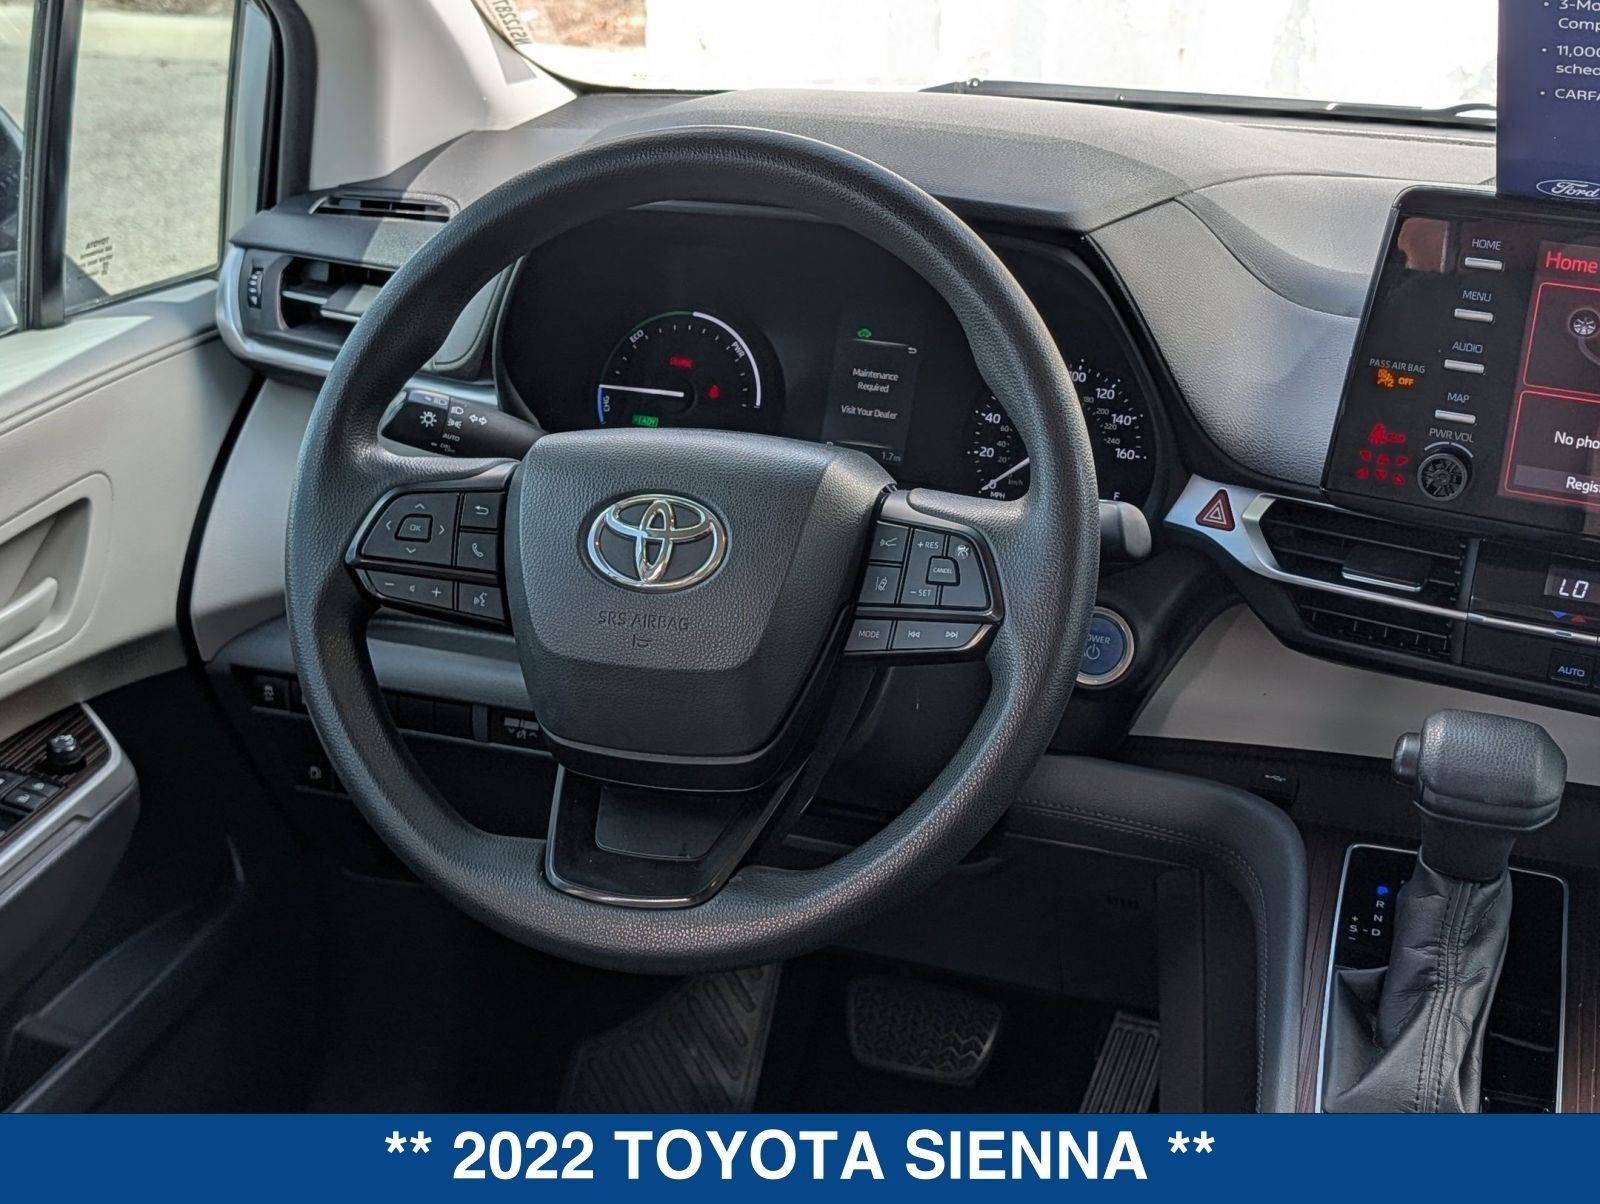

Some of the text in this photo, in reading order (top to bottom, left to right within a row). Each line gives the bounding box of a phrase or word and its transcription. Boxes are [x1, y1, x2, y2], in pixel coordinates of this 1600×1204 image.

[1551, 181, 1600, 199] Ford
[1471, 238, 1502, 251] HOME
[1545, 251, 1599, 274] Home
[1462, 290, 1492, 303] MENU
[629, 329, 645, 343] ECO
[731, 341, 745, 359] PWR
[1452, 341, 1483, 354] AUDIO
[1369, 358, 1391, 369] PASS
[1391, 361, 1407, 371] AIR
[852, 367, 899, 382] Maintenance
[1069, 371, 1087, 383] 00
[857, 381, 890, 393] Required
[1398, 377, 1415, 386] OFF
[1095, 387, 1116, 400] 120
[1447, 392, 1470, 403] MAP
[840, 404, 898, 420] Visit Your Dealer
[984, 412, 1001, 425] 40
[1111, 413, 1133, 426] 140
[442, 432, 461, 442] AUTO
[1428, 426, 1475, 444] PWR VOL
[1554, 430, 1573, 446] No
[979, 446, 995, 458] 20
[1115, 447, 1135, 461] 160
[1566, 476, 1600, 494] Regis
[1113, 492, 1121, 500] F
[409, 523, 421, 532] OK
[1558, 578, 1590, 599] LO
[598, 610, 626, 626] SRS
[858, 629, 880, 639] MODE
[1087, 632, 1111, 645] OWER
[1557, 665, 1586, 678] AUTO
[1375, 900, 1385, 909] R
[1373, 913, 1383, 922] N
[1349, 924, 1359, 933] S
[1371, 928, 1381, 937] D
